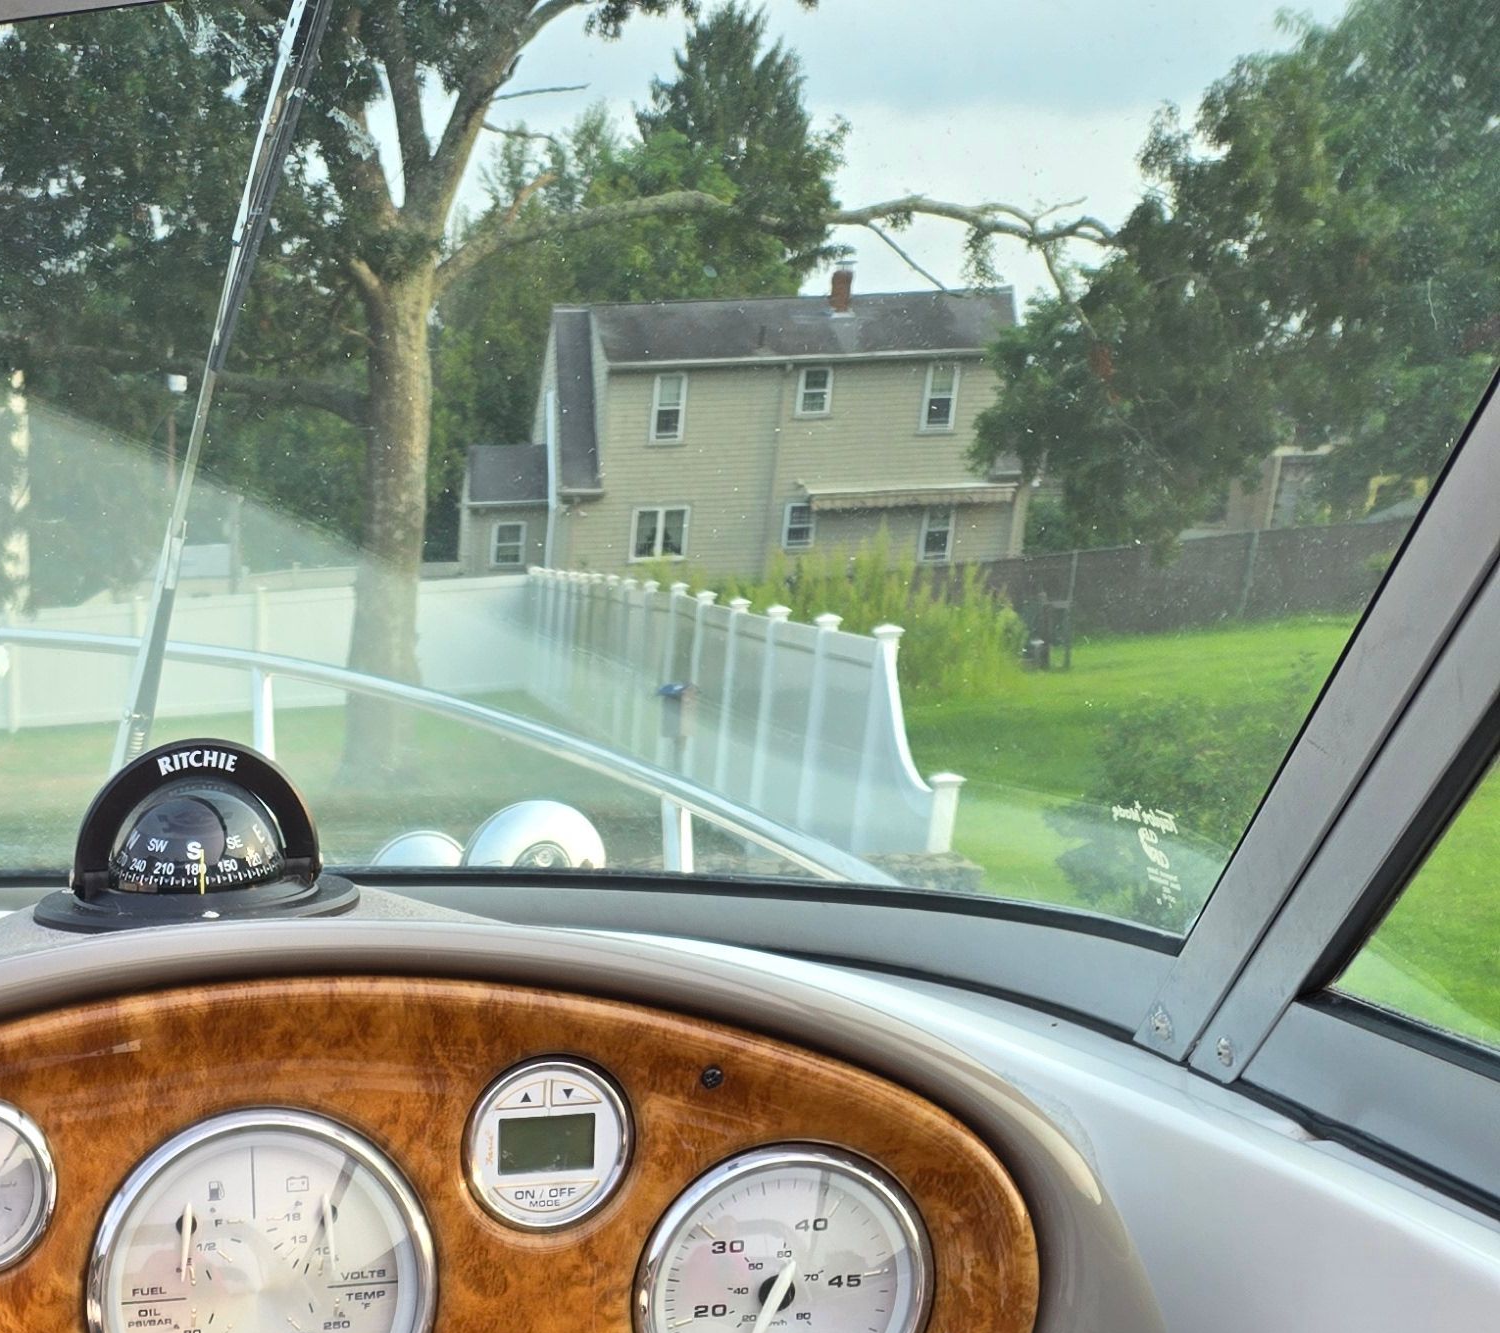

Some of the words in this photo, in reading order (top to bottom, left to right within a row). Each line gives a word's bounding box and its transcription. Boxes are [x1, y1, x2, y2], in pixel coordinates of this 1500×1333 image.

[157, 750, 238, 776] RITCHIE
[148, 838, 168, 852] SW
[187, 842, 202, 860] S
[226, 835, 243, 849] SE
[129, 860, 146, 872] 240
[153, 863, 174, 875] 210
[185, 864, 207, 875] 180
[218, 859, 238, 873] 150
[515, 1190, 535, 1200] ON
[549, 1187, 576, 1198] OFF
[215, 1219, 223, 1228] F
[795, 1218, 828, 1232] 40
[291, 1235, 308, 1244] 13
[197, 1243, 216, 1252] 1/2
[712, 1240, 744, 1254] 30
[341, 1269, 386, 1281] VOLTS
[804, 1273, 819, 1281] 70
[828, 1274, 862, 1288] 45
[132, 1287, 167, 1296] FUEL
[346, 1290, 386, 1301] TEMP
[734, 1287, 749, 1295] 40
[138, 1308, 161, 1318] OIL
[694, 1304, 727, 1318] 20
[323, 1321, 350, 1330] 250
